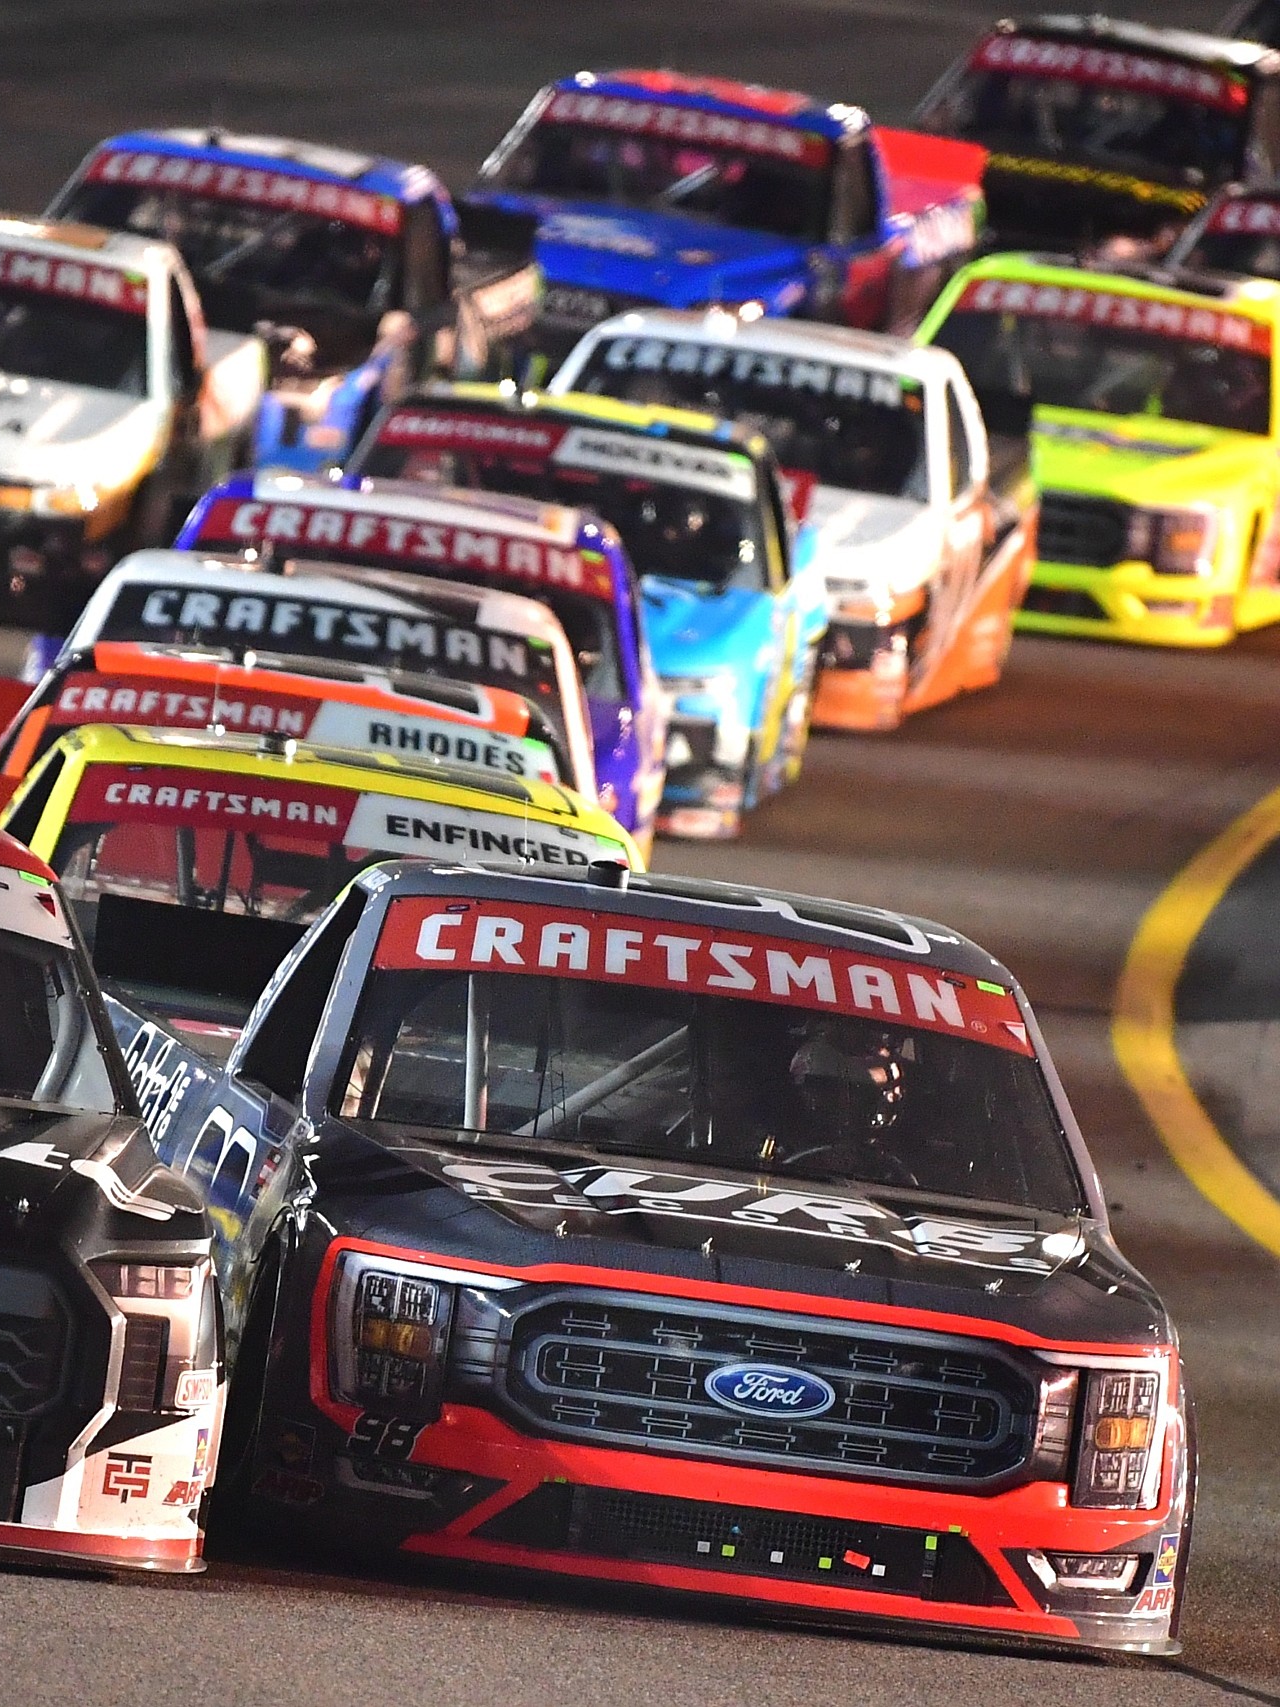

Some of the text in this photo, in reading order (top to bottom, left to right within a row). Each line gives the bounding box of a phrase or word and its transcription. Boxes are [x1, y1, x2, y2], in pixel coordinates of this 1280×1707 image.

[974, 279, 1253, 346] CRAFTSMAN
[605, 338, 902, 408] CRAFTSMAN
[231, 503, 584, 587] CRAFTSMAN
[141, 590, 529, 677] CRAFTSMAN
[59, 685, 528, 780] CRAFTSMAN RHODES
[104, 782, 339, 827] CRAFTSMAN
[415, 913, 965, 1029] CRAFTSMAN
[442, 1164, 1037, 1255] CURB
[462, 1183, 1052, 1270] RECORDS
[733, 1371, 803, 1406] Ford
